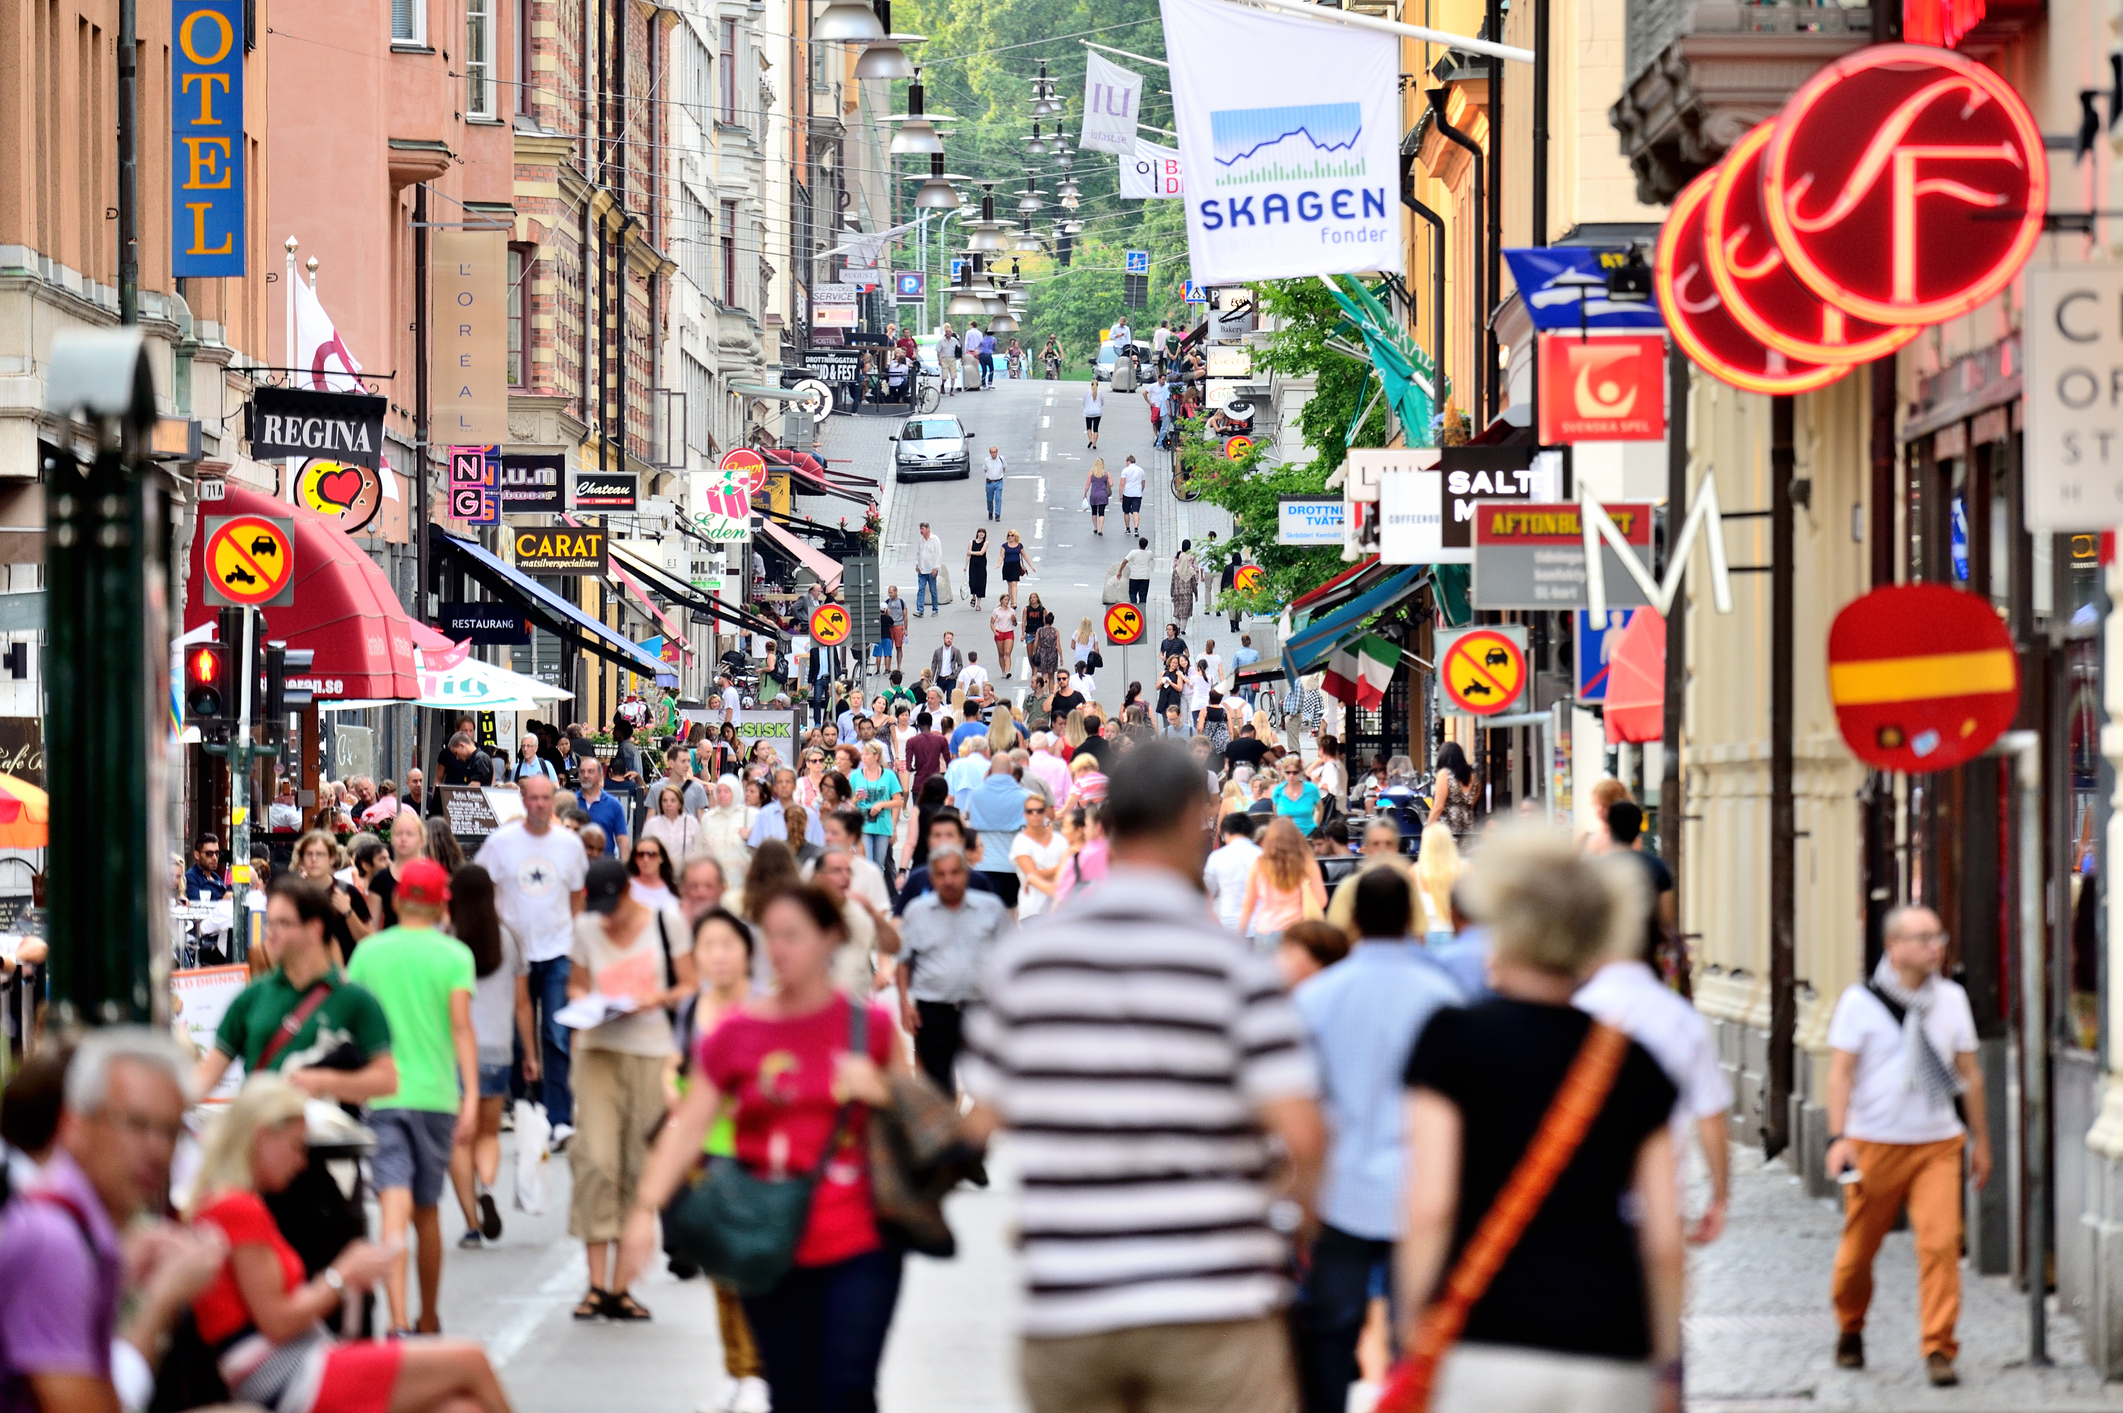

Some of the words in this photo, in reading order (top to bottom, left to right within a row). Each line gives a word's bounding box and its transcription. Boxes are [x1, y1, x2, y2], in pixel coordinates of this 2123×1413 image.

[179, 0, 234, 256] OTEL
[1090, 129, 1127, 144] iufast.se
[1786, 74, 2026, 305] SF
[1200, 187, 1387, 231] SKAGEN
[1320, 227, 1388, 245] fonder
[904, 277, 917, 292] P
[813, 292, 854, 301] SERVICE
[1220, 325, 1243, 335] Bakery
[457, 263, 474, 428] L'ORÉAL
[813, 337, 837, 345] HOSTEL
[805, 355, 858, 364] DROTTNINGGATAN
[837, 363, 857, 380] FEST
[262, 414, 373, 453] REGINA
[1560, 420, 1618, 434] SVENSKA
[1619, 420, 1651, 433] SPEL
[206, 483, 224, 498] 71A
[575, 480, 631, 496] Chateau
[691, 511, 748, 540] Eden
[515, 533, 603, 558] CARAT
[516, 558, 600, 570] -matsilverspecialisten
[452, 619, 514, 629] RESTAURANG
[196, 974, 246, 988] DRINKS
